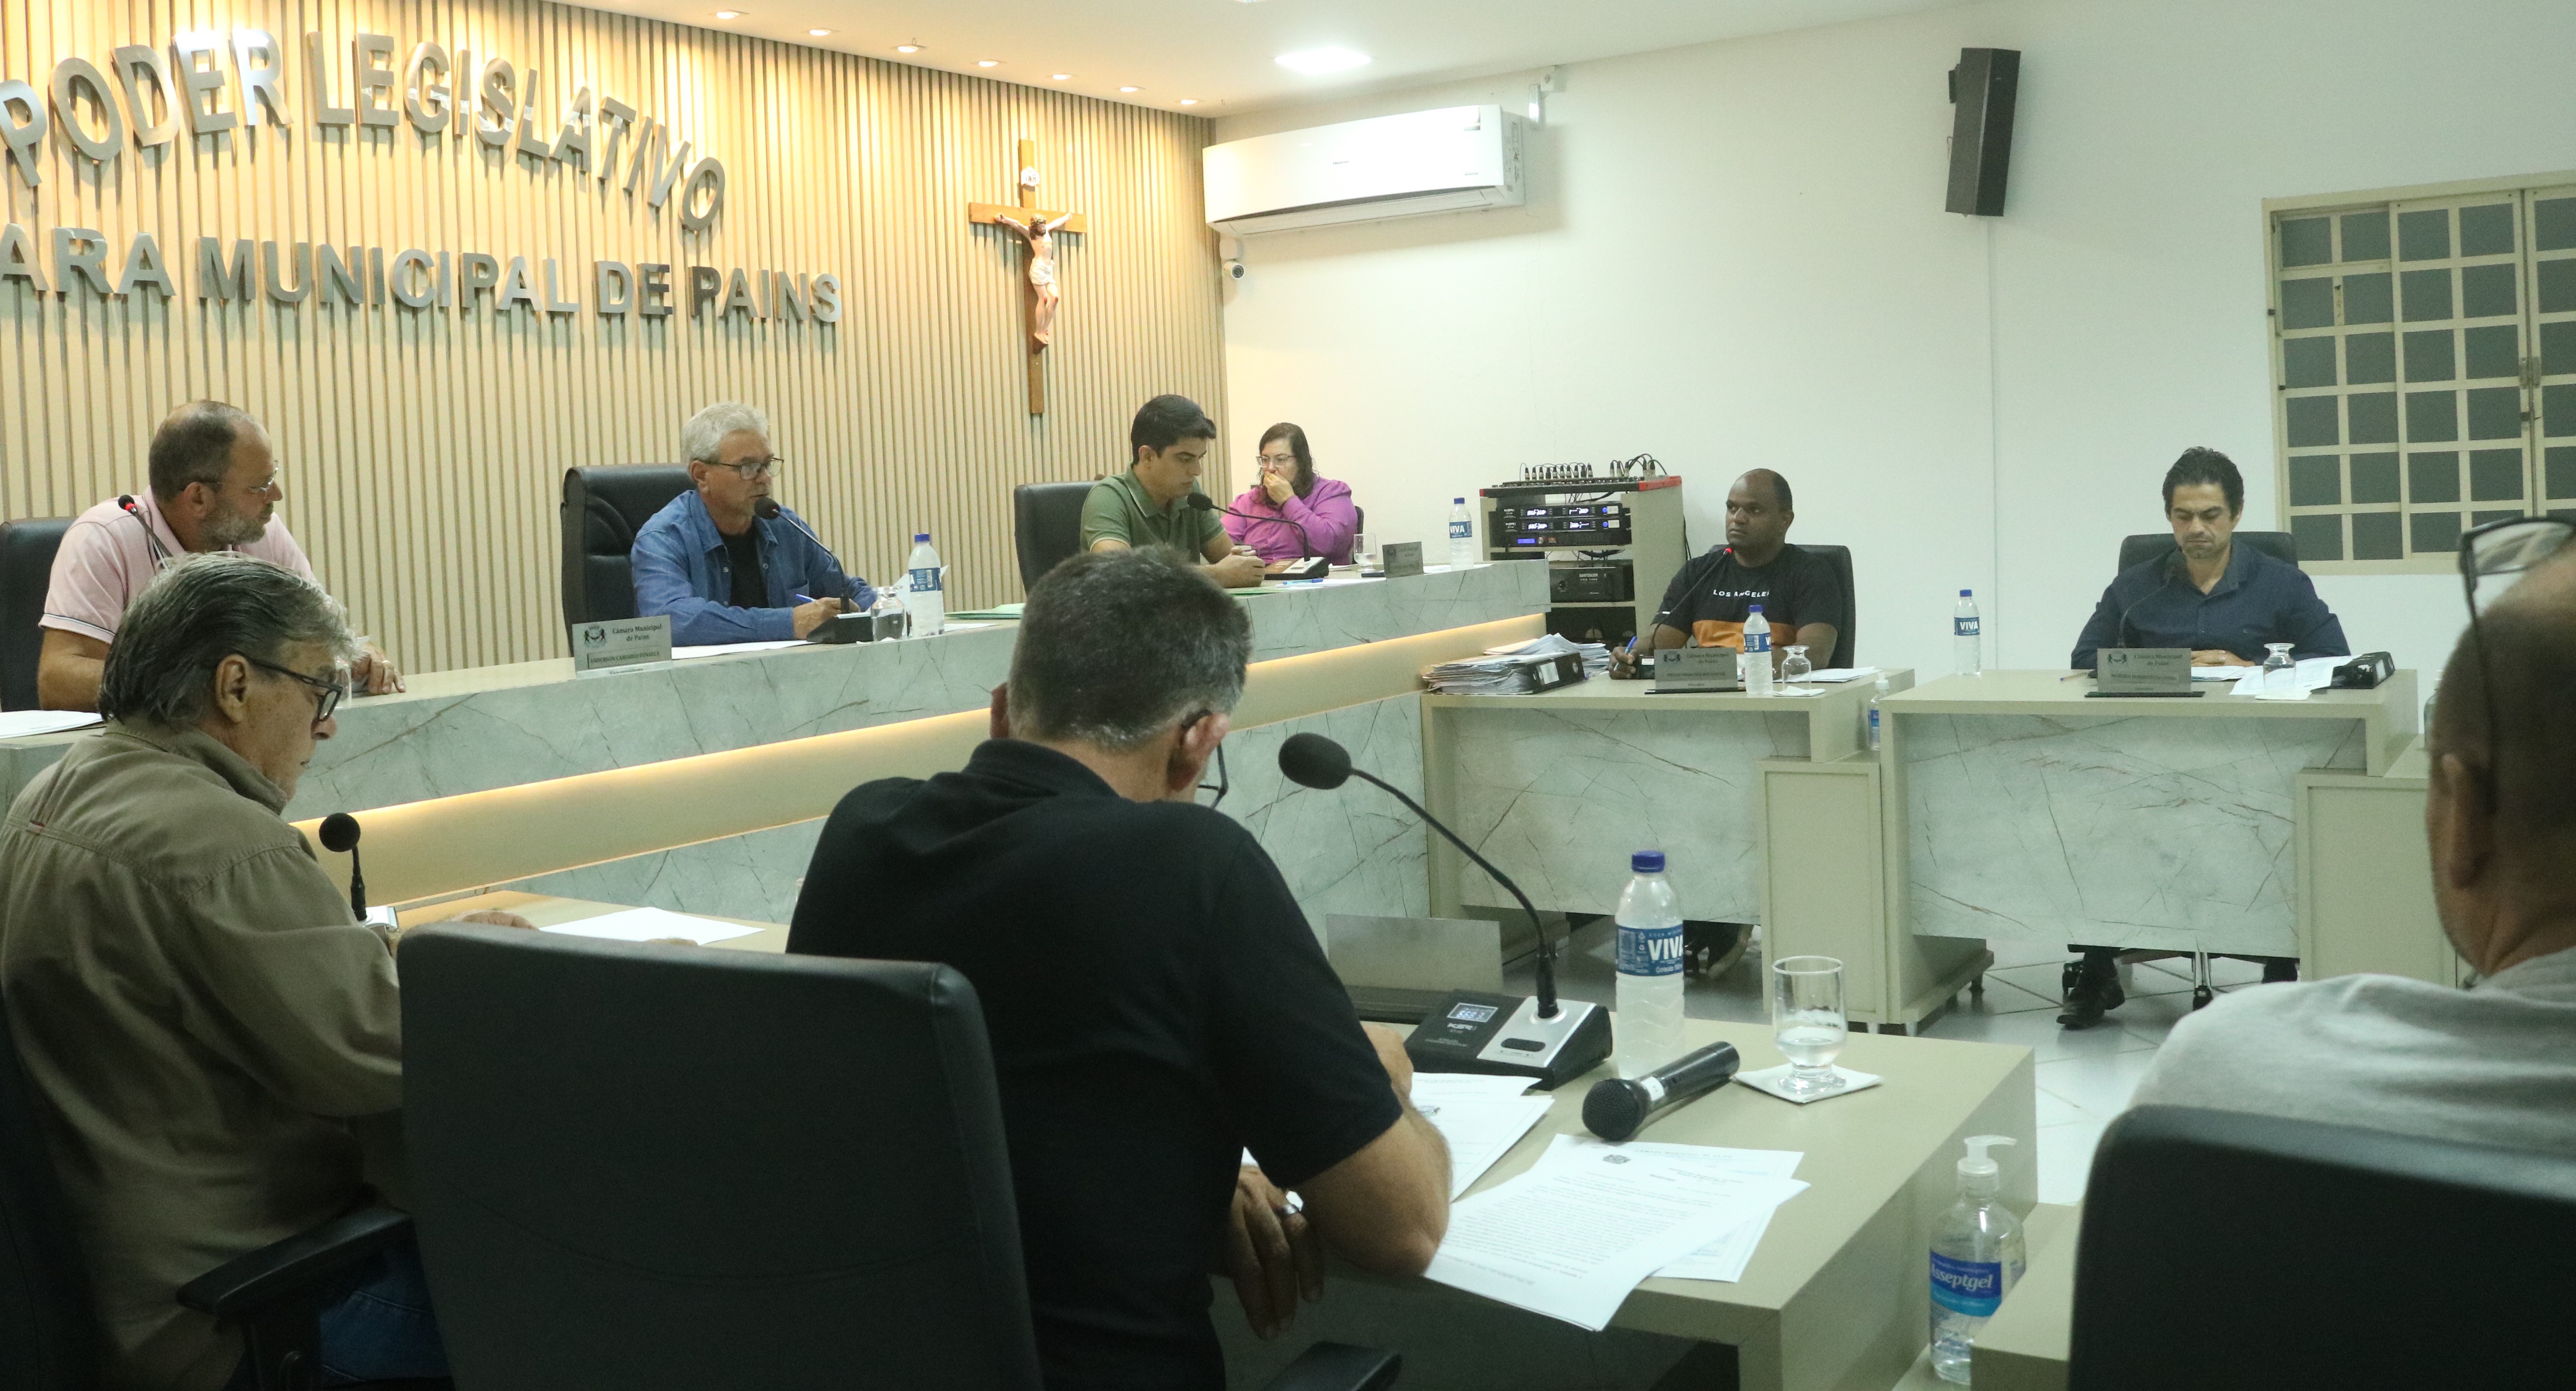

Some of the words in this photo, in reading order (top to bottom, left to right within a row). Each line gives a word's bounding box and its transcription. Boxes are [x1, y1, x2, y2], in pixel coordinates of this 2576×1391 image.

[0, 29, 293, 187] PODER
[307, 31, 725, 232] LEGISLATIVO
[196, 236, 581, 313] MUNICIPAL
[594, 261, 674, 315] DE
[687, 265, 843, 323] PAINS
[1450, 525, 1465, 533] VIVA
[1960, 621, 1978, 630] VIVA
